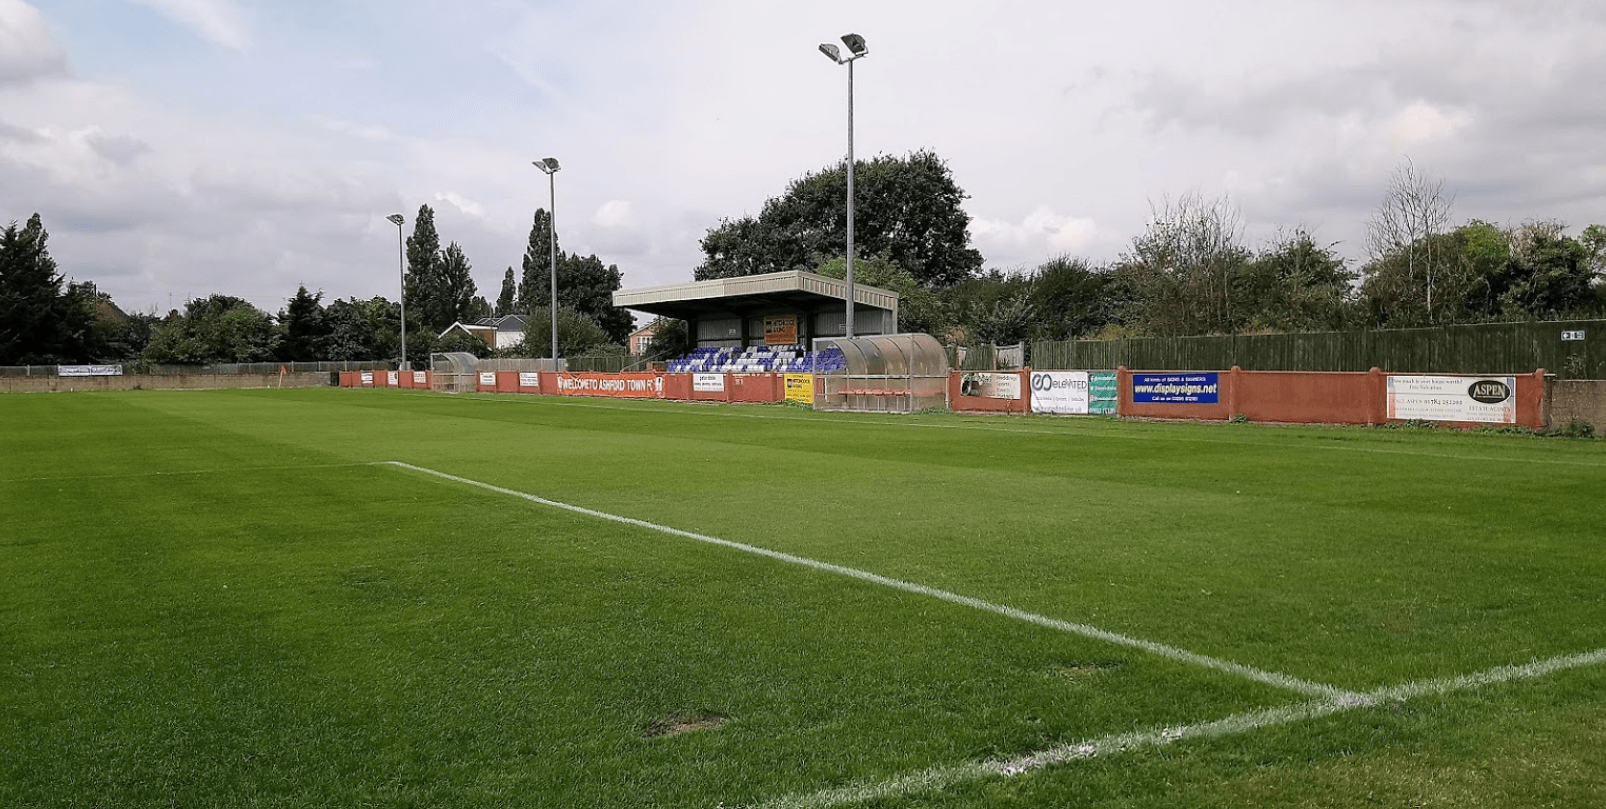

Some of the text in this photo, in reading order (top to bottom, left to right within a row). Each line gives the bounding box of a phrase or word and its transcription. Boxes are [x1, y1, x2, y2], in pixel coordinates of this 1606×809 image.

[627, 379, 646, 391] TOWN
[1134, 383, 1217, 395] www.displaysigns.net
[1473, 384, 1506, 398] ASPEN
